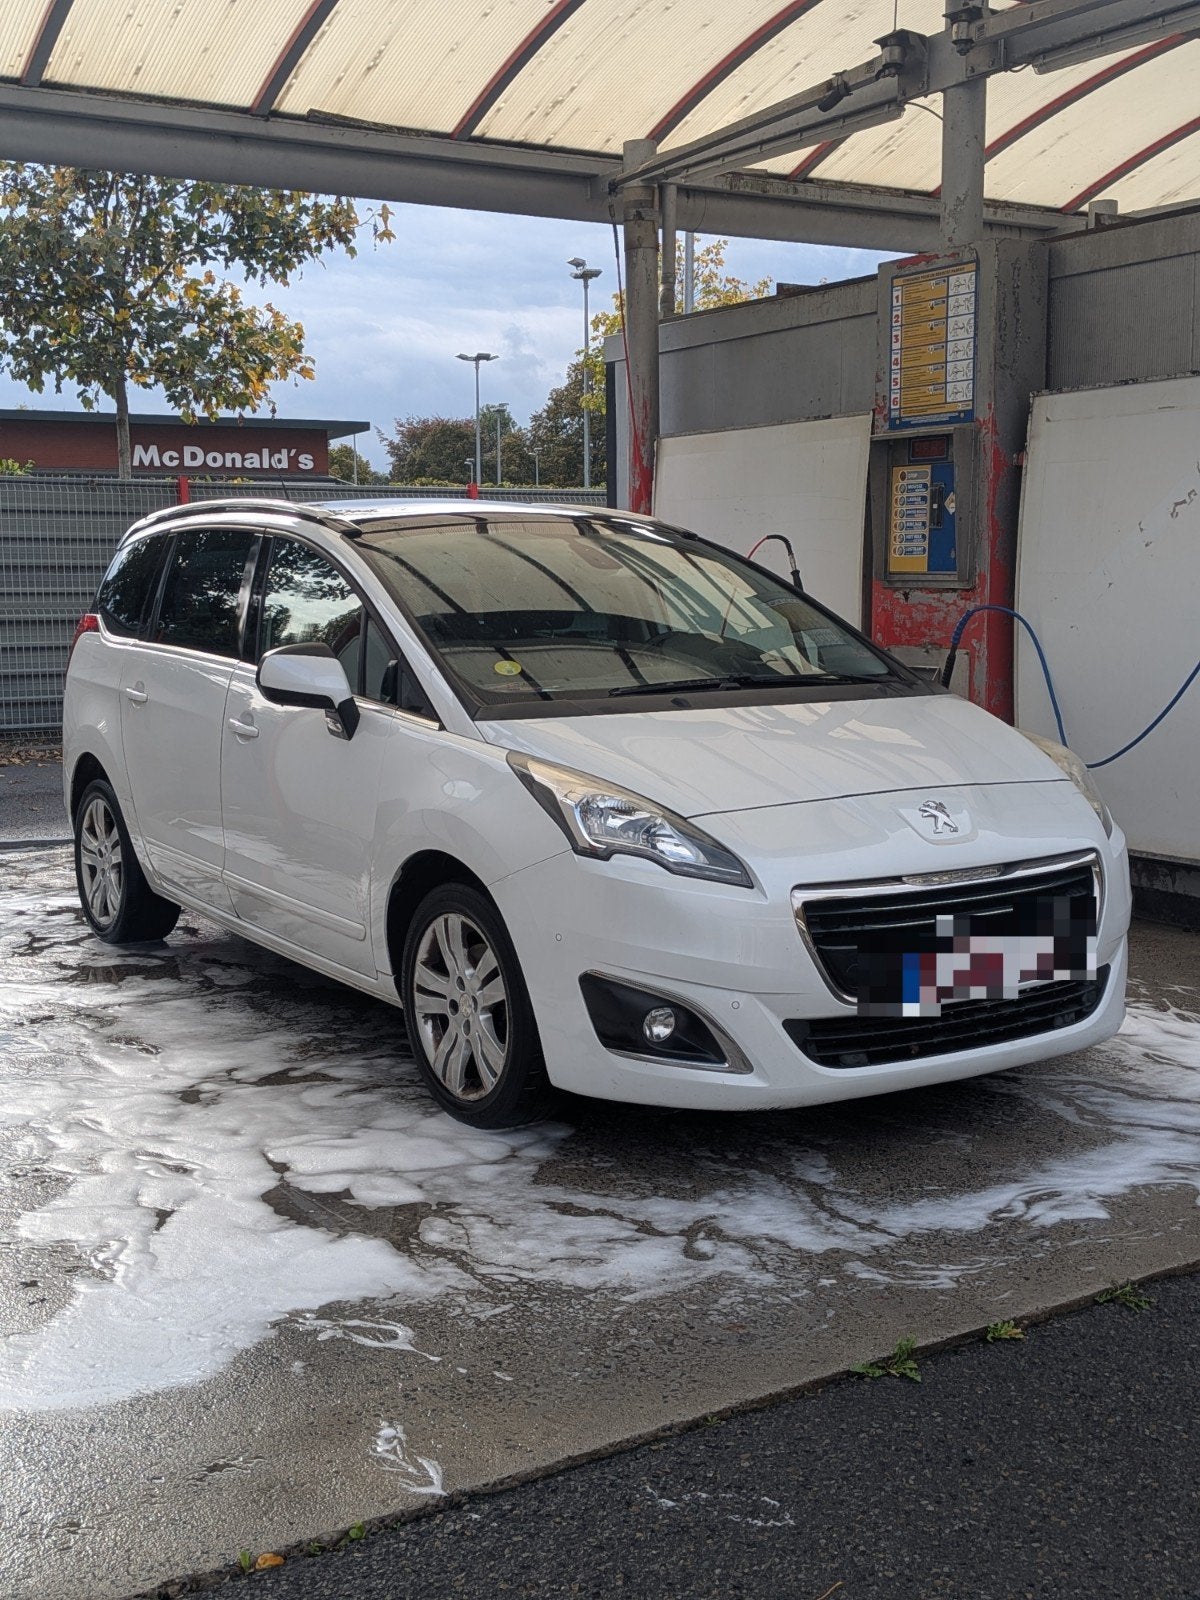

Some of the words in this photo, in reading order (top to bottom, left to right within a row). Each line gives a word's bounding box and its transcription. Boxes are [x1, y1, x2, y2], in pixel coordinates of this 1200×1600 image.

[894, 294, 900, 304] 1
[893, 314, 900, 323] 2
[893, 334, 899, 344] 3
[893, 357, 899, 367] 4
[892, 377, 899, 386] 5
[892, 396, 899, 406] 6
[132, 444, 315, 470] McDonald's
